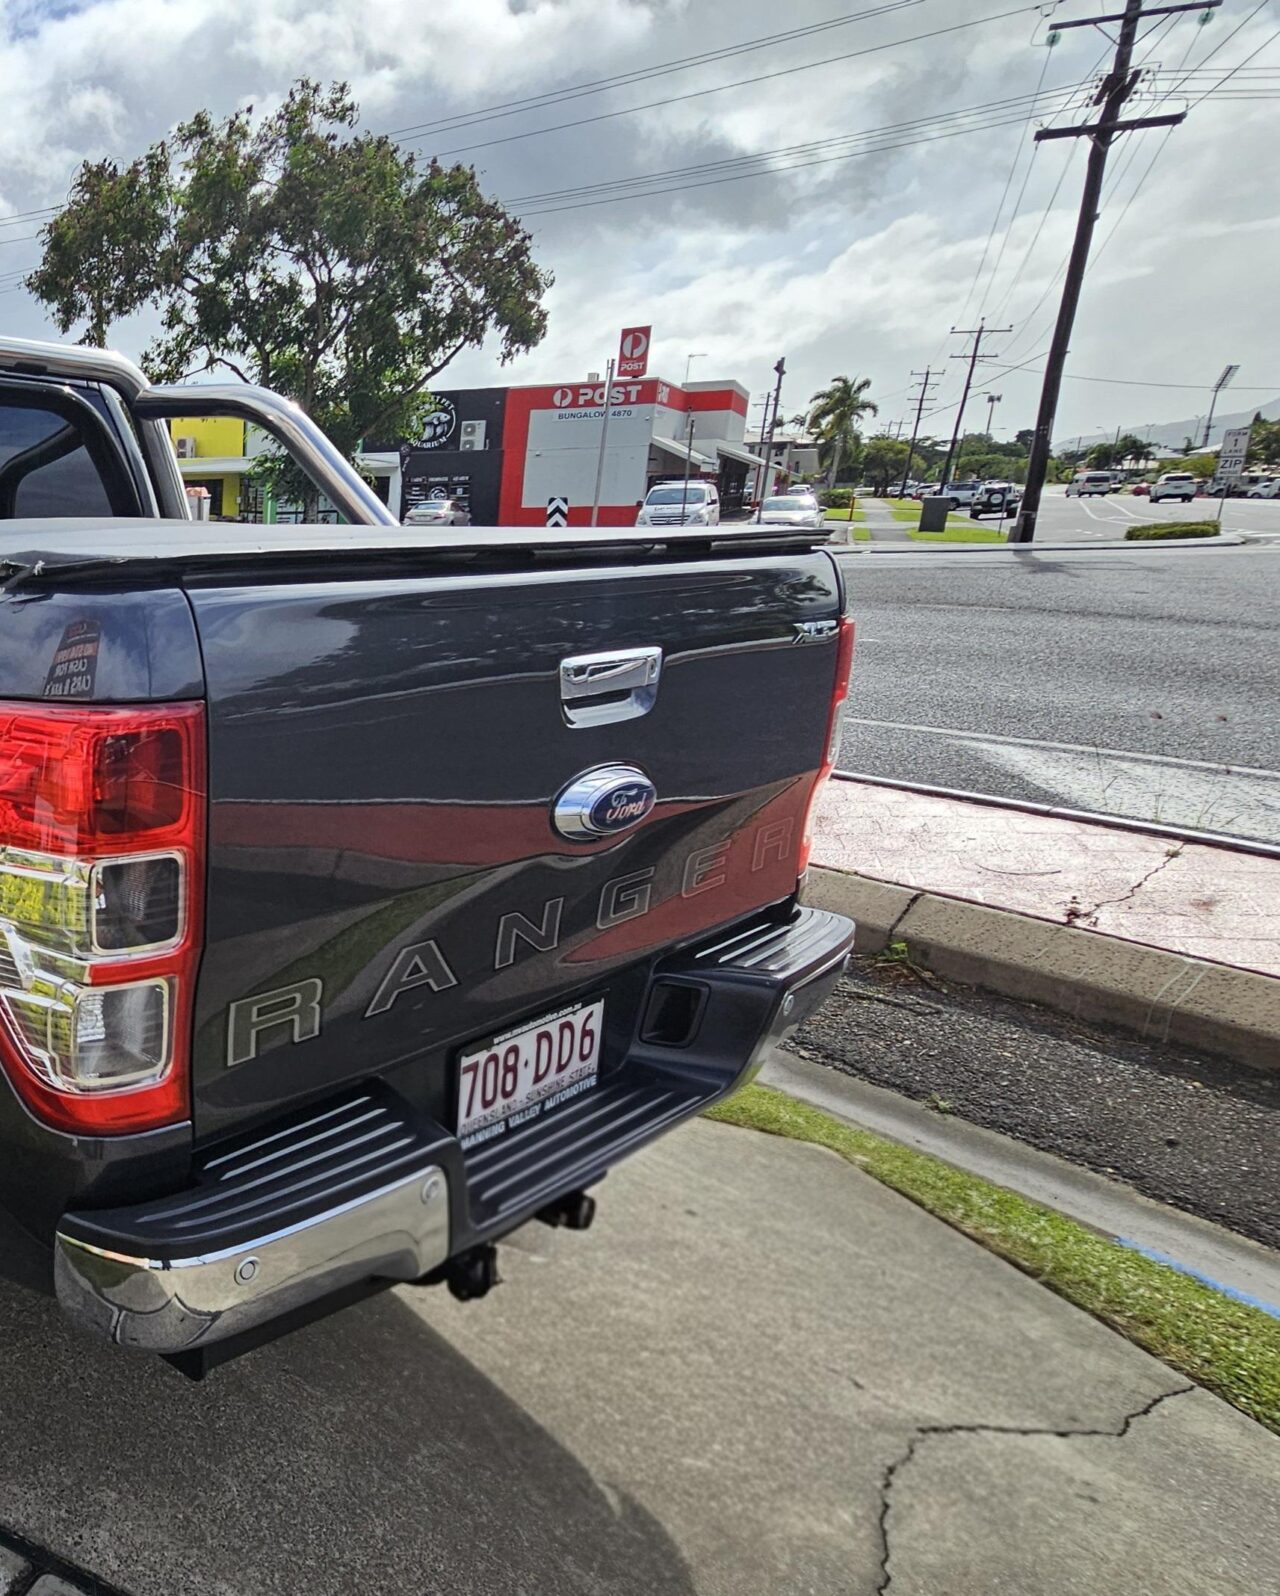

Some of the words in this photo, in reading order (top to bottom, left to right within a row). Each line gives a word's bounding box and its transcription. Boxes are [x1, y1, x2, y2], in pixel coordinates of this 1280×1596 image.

[620, 361, 645, 371] POST
[578, 384, 642, 406] POST
[611, 409, 632, 417] 4870
[1220, 459, 1242, 469] ZIP
[606, 788, 647, 823] Ford
[226, 815, 794, 1068] RANGER
[460, 1099, 518, 1135] QUEENSLAND
[525, 1075, 566, 1102] SUNSHINE
[460, 1121, 506, 1151] MANNING
[508, 1102, 542, 1129] VALLEY
[543, 1074, 598, 1112] AUTOMOTIVE
